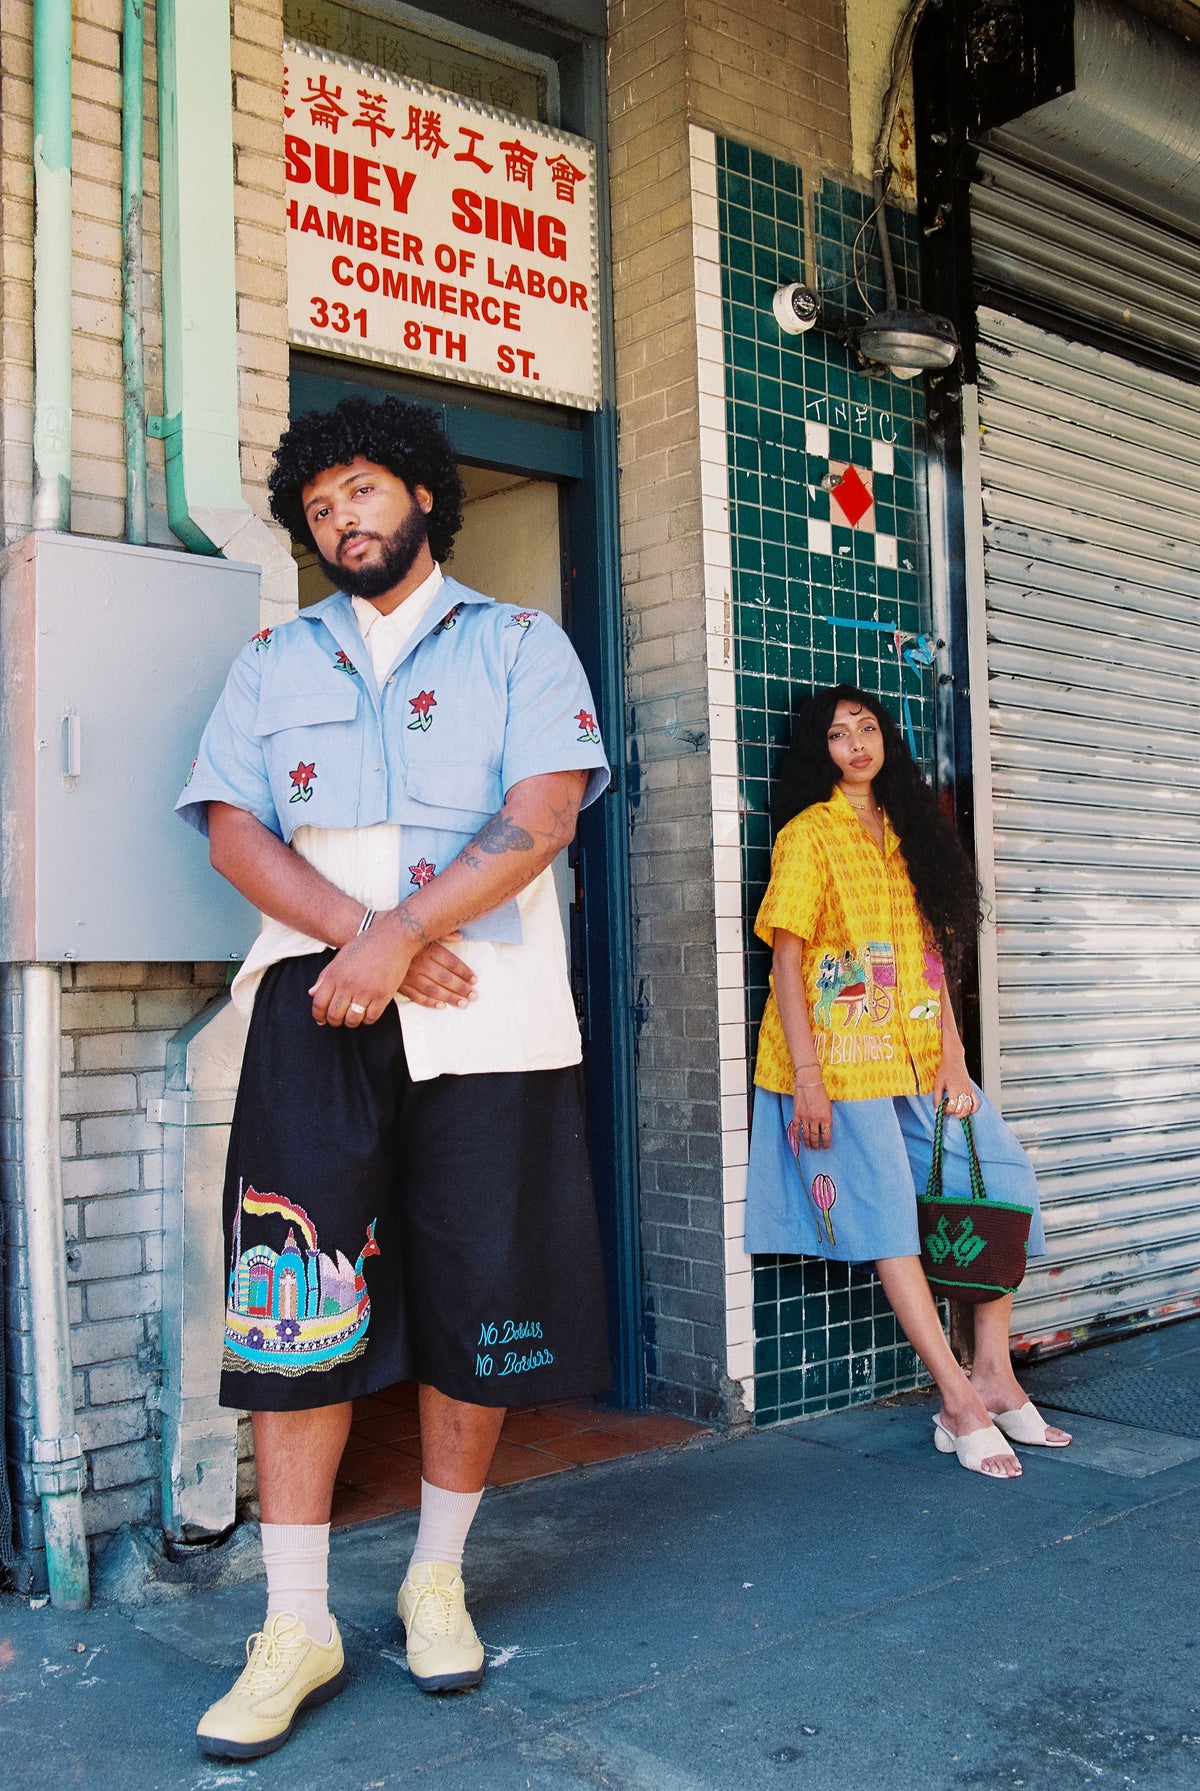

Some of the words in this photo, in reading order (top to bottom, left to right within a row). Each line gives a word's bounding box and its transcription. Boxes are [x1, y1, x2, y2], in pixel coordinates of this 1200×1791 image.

[281, 67, 587, 204] 崙萃勝工商會
[284, 134, 417, 215] SUEY
[451, 188, 568, 262] SING
[286, 199, 425, 267] HAMBER
[434, 244, 476, 279] OF
[487, 257, 589, 312] LABOR
[331, 255, 522, 333] COMMERCE
[309, 297, 368, 339] 331
[403, 320, 467, 363] 8TH
[496, 345, 540, 381] ST.
[814, 1032, 826, 1062] O
[830, 1031, 894, 1065] BORDERS
[475, 1353, 493, 1377] NO
[478, 1322, 498, 1346] NO
